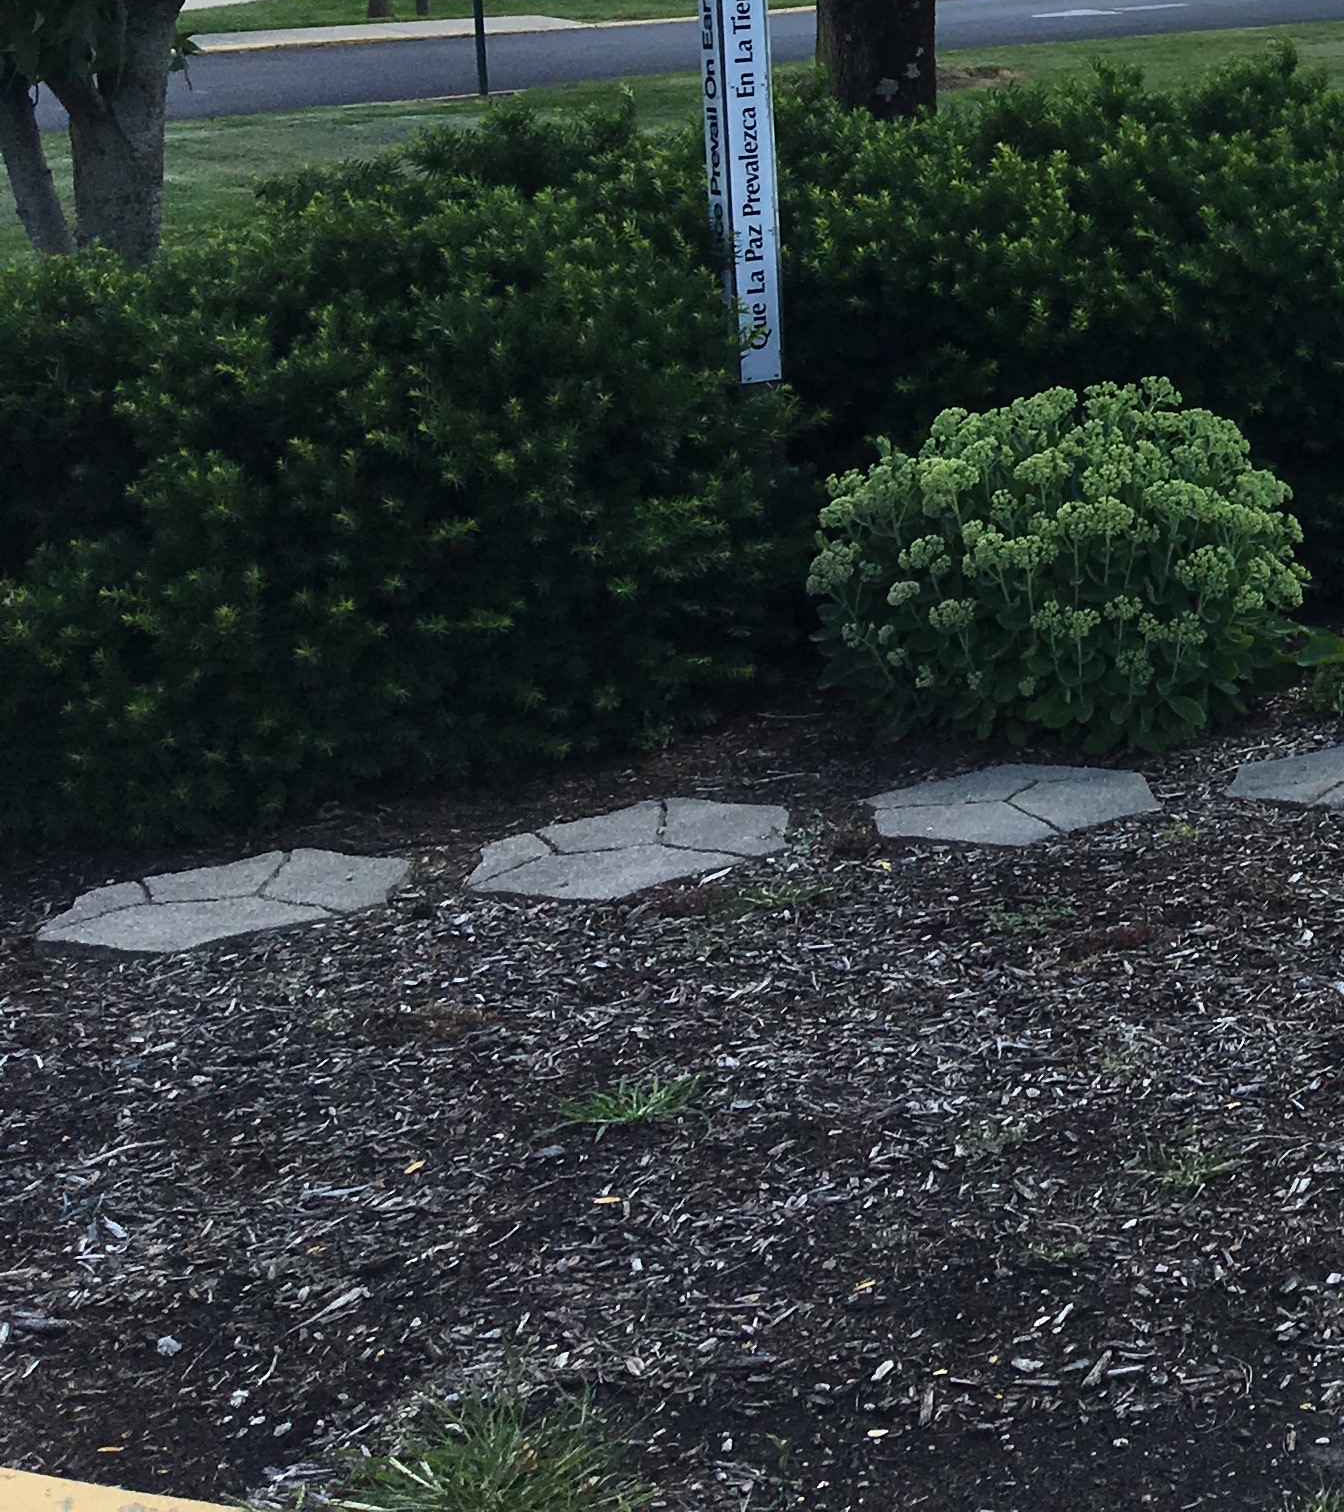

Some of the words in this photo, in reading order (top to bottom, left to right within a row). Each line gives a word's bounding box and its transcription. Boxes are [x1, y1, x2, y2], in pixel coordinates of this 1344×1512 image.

[733, 40, 752, 63] La
[701, 54, 717, 100] On
[735, 73, 754, 97] En
[705, 107, 722, 196] Prevail
[737, 106, 761, 216] Prevalezca
[742, 224, 763, 261] Paz
[744, 270, 765, 294] La
[744, 303, 771, 350] Que
